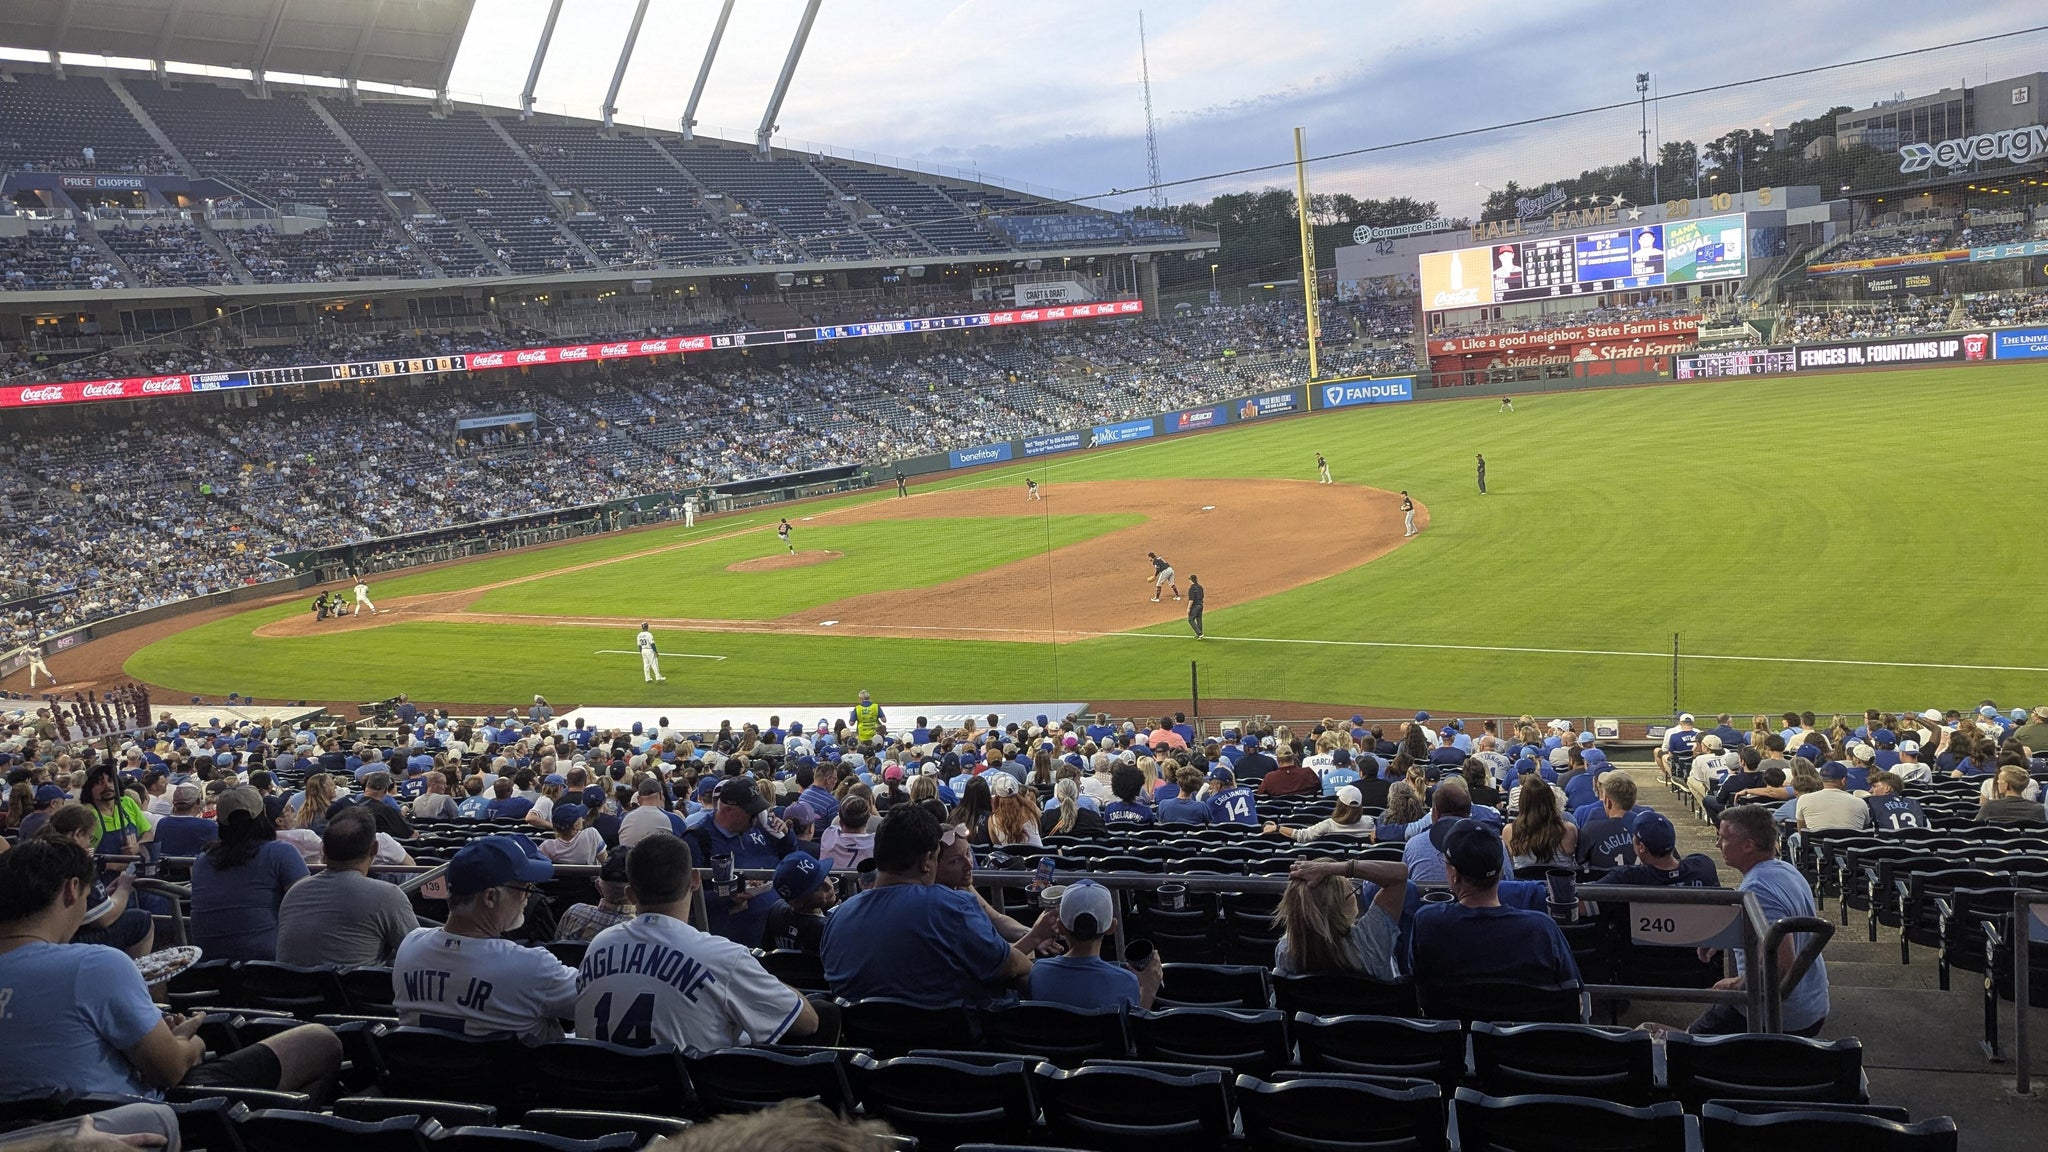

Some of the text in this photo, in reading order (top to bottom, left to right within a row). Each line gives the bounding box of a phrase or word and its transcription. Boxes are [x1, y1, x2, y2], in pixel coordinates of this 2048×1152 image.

[64, 177, 142, 188] PRICE CHOPPER
[1515, 185, 1567, 218] Royals
[1709, 192, 1732, 212] 10
[1758, 187, 1772, 206] 5
[1665, 198, 1691, 218] 20
[1372, 219, 1450, 238] Commerce Bank
[1471, 204, 1618, 242] HALL of FAME
[1670, 222, 1697, 238] BANK
[1596, 240, 1611, 250] 0-2
[1667, 234, 1712, 260] ROYAL
[1670, 233, 1691, 248] LIKE
[1375, 240, 1395, 256] 42
[1868, 279, 1893, 289] planet
[1871, 284, 1898, 292] fitness
[1026, 290, 1043, 299] CRAFT
[1049, 289, 1066, 297] DRAFT
[1072, 306, 1090, 316] Coca-Cola
[1097, 303, 1114, 313] Coca-Cola
[1121, 301, 1138, 311] Coca-Cola
[994, 312, 1012, 322] Coca-Cola
[1021, 310, 1039, 321] Coca-Cola
[1046, 308, 1065, 318] Coca-Cola
[821, 328, 832, 339] KC
[884, 322, 905, 332] COLLINS
[1461, 318, 1700, 351] Like a good neighbor, State Farm is ther
[2001, 336, 2019, 344] THE
[641, 341, 667, 353] Coca-Cola
[679, 338, 705, 350] Coca-Cola
[716, 338, 730, 346] 8:08
[1968, 341, 1983, 353] QT
[517, 350, 547, 363] Coca-Cola
[560, 347, 588, 360] Coca-Cola
[601, 344, 628, 356] Coca-Cola
[1800, 340, 1959, 367] FENCES IN, FOUNTAINS UP
[384, 363, 390, 372] B
[399, 362, 406, 372] 2
[413, 362, 419, 370] S
[455, 358, 462, 368] 2
[473, 354, 504, 366] Coca-Cola
[1680, 361, 1691, 369] MIL
[1738, 357, 1749, 366] PHI
[200, 374, 229, 382] GUARDIANS
[1680, 370, 1691, 379] STL
[1738, 366, 1751, 375] MIA
[83, 382, 124, 398] Coca-Cola
[143, 378, 182, 393] Coca-Cola
[1346, 384, 1407, 400] FANDUEL
[21, 386, 64, 402] Coca-Cola
[1096, 430, 1120, 443] UMKC
[959, 448, 1000, 463] benefitbay
[1706, 759, 1722, 770] WITT
[1329, 775, 1353, 785] WITT JR
[1215, 789, 1251, 807] CAGLIANONE
[1225, 797, 1250, 822] 14
[1110, 812, 1144, 823] CAGLIANONE
[1889, 812, 1918, 830] 13
[750, 832, 766, 847] KC
[1598, 832, 1632, 855] CAGLIA
[846, 848, 859, 868] 7
[796, 858, 815, 875] KC
[425, 882, 440, 892] 139
[1639, 917, 1676, 933] 240
[575, 942, 717, 1004] CAGLIANONE
[404, 969, 494, 1012] WITT JR
[593, 991, 656, 1049] 14
